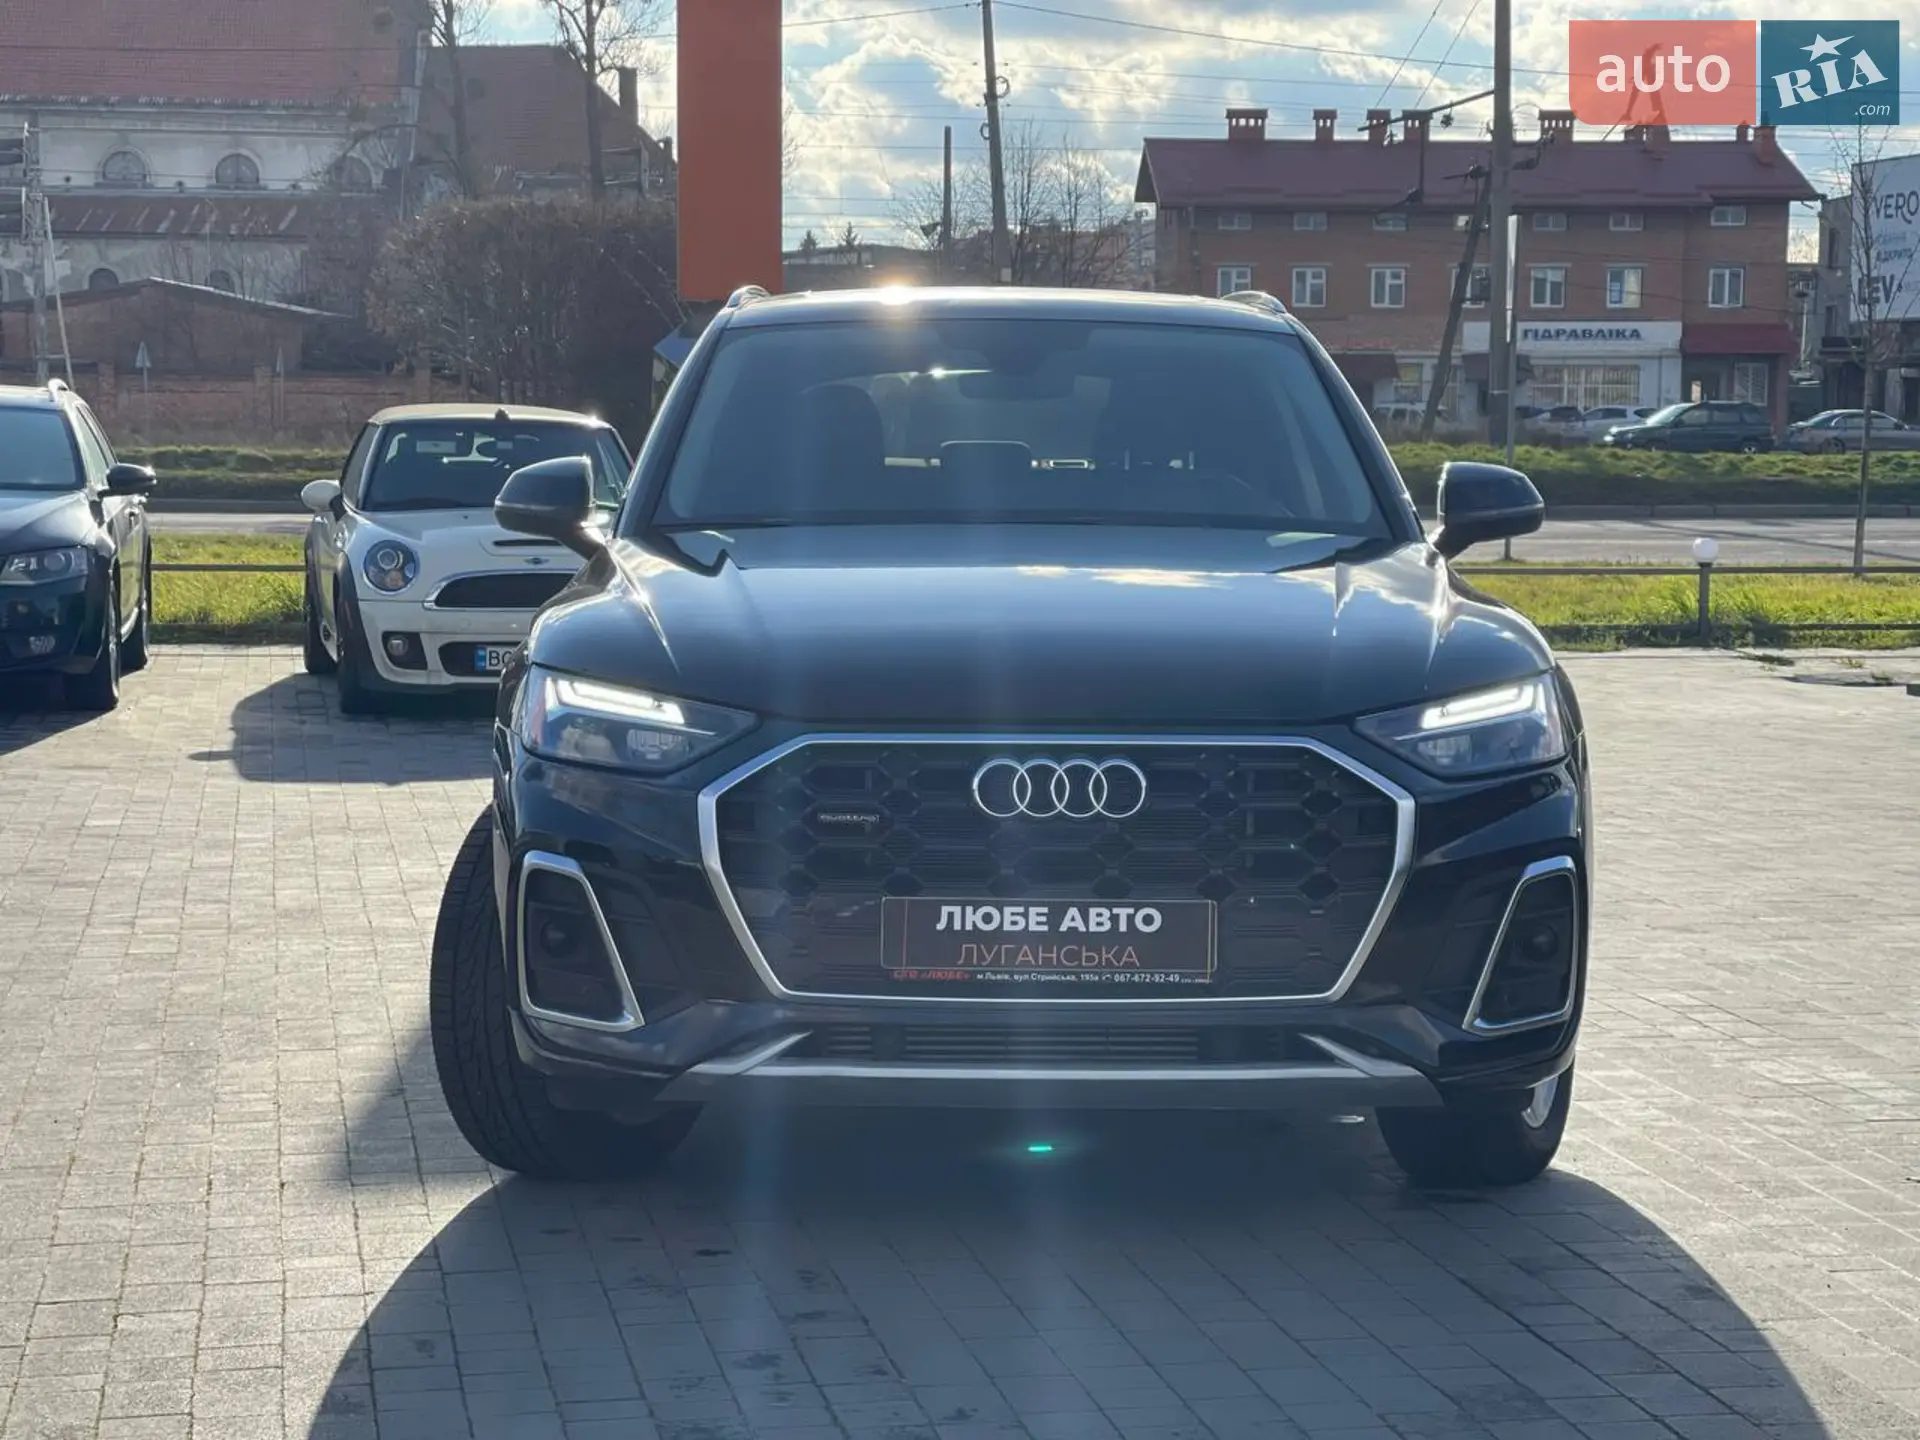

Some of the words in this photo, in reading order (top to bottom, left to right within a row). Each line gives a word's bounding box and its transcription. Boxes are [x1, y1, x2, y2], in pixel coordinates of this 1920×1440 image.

[1523, 328, 1642, 341] ГІДРАВЛІКА
[936, 905, 1049, 932] ЛЮБЕ
[1059, 907, 1162, 933] АВТО
[957, 944, 1140, 967] ЛУГАНСЬКА
